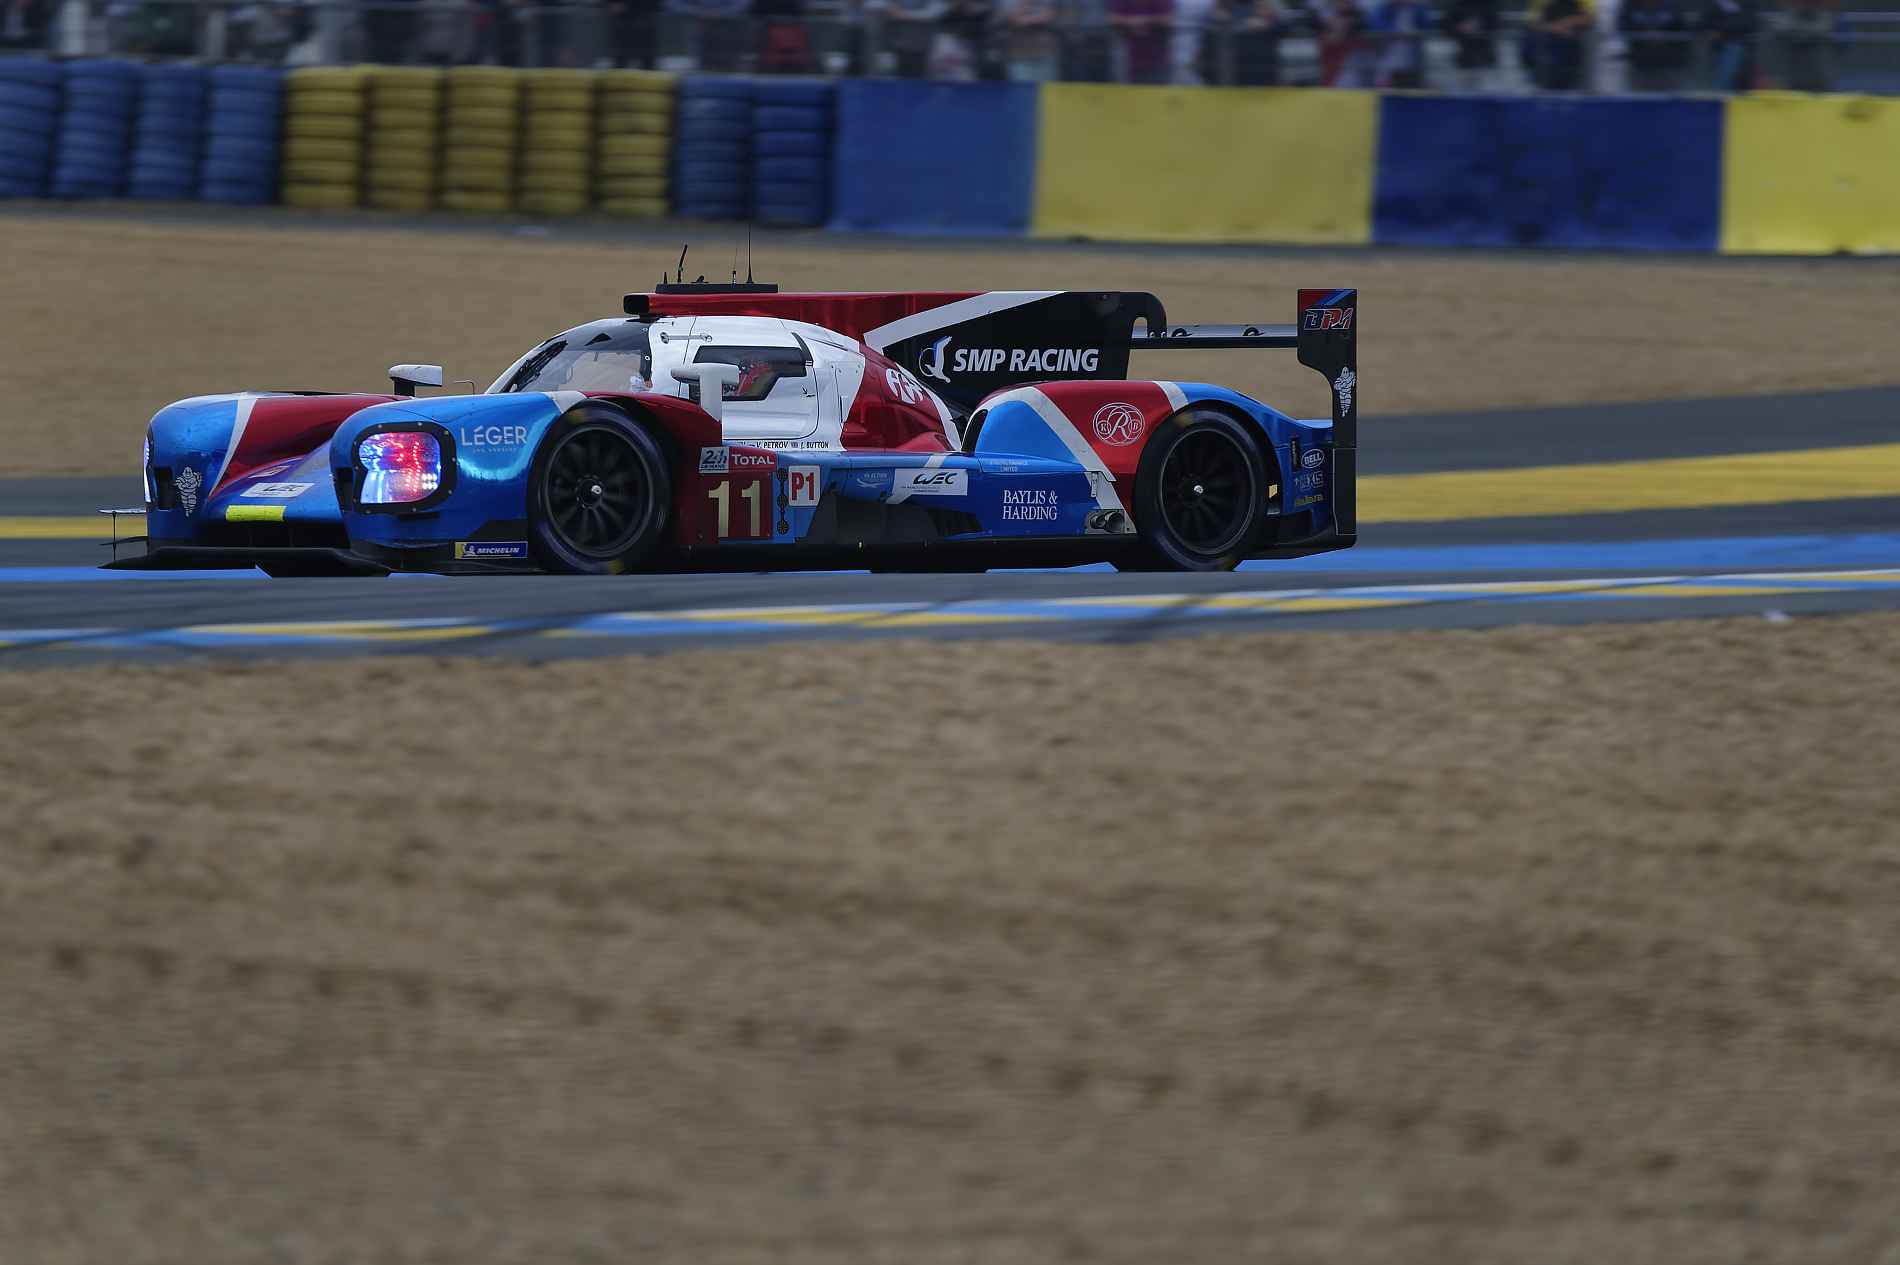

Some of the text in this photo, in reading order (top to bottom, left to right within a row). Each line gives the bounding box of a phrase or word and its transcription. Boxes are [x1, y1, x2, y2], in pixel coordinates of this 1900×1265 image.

[953, 349, 1099, 373] SMP RACING
[461, 425, 527, 446] LÉGER
[763, 441, 788, 449] PETROV
[806, 441, 829, 449] BUTTON
[1304, 452, 1322, 465] BELL
[913, 472, 958, 485] WEC
[791, 472, 815, 501] P1
[1003, 490, 1058, 504] BAYLIS &
[708, 480, 760, 537] 11
[1002, 506, 1057, 520] HARDING
